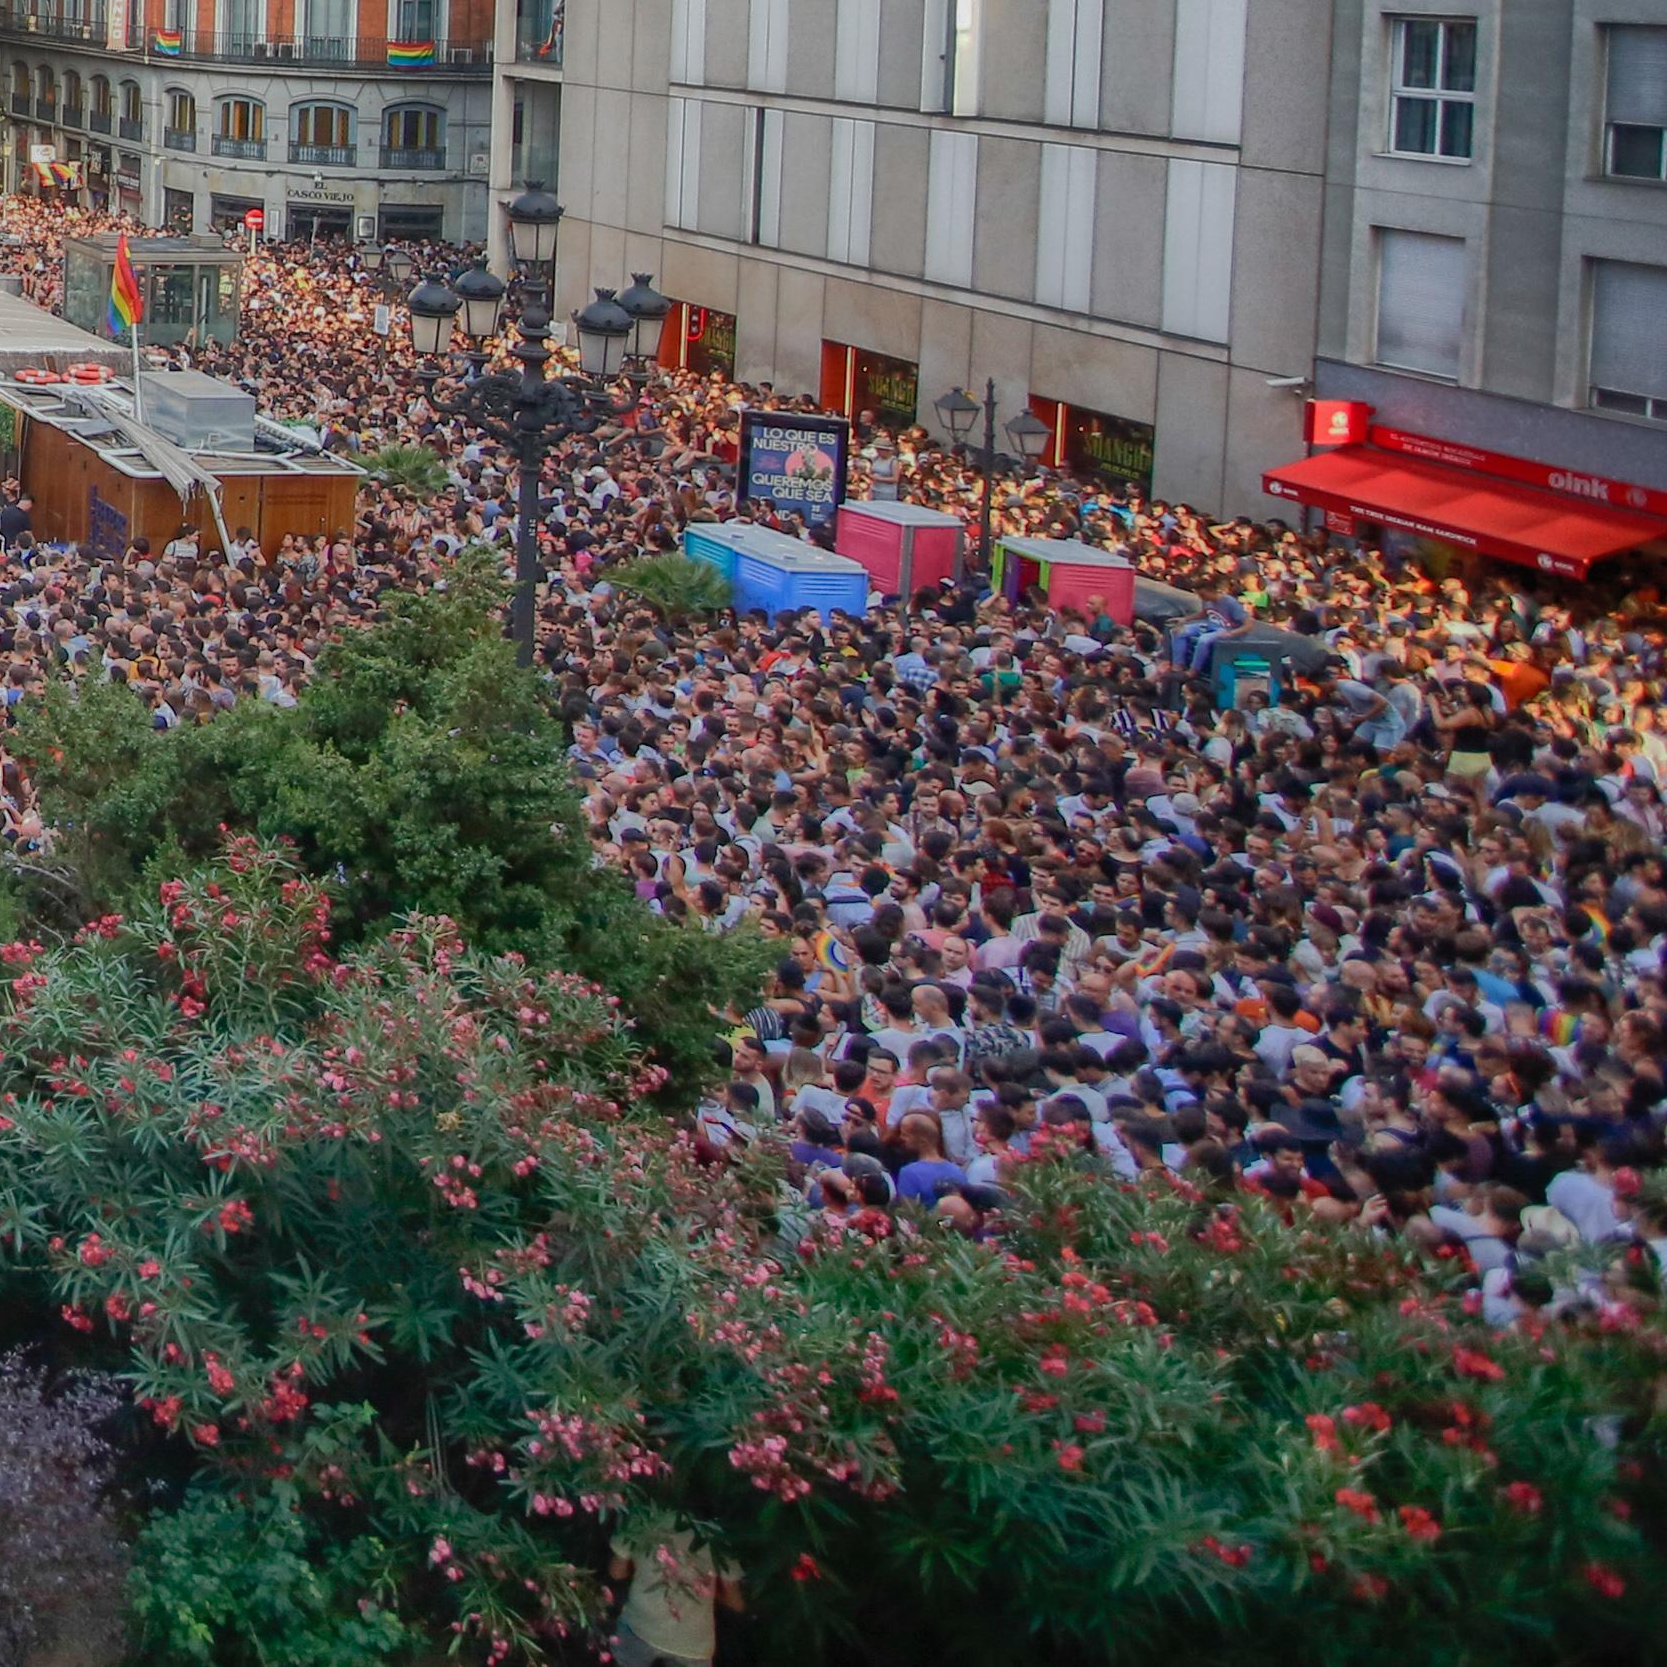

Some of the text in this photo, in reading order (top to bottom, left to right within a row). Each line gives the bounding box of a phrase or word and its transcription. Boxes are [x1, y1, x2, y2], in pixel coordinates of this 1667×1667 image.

[287, 189, 323, 200] CASCO
[762, 427, 836, 445] LO QUE ES
[753, 437, 819, 454] NUESTRO
[752, 472, 833, 492] QUEREMOS
[1548, 471, 1609, 500] oink
[772, 486, 804, 501] QUE
[805, 490, 833, 504] SEA
